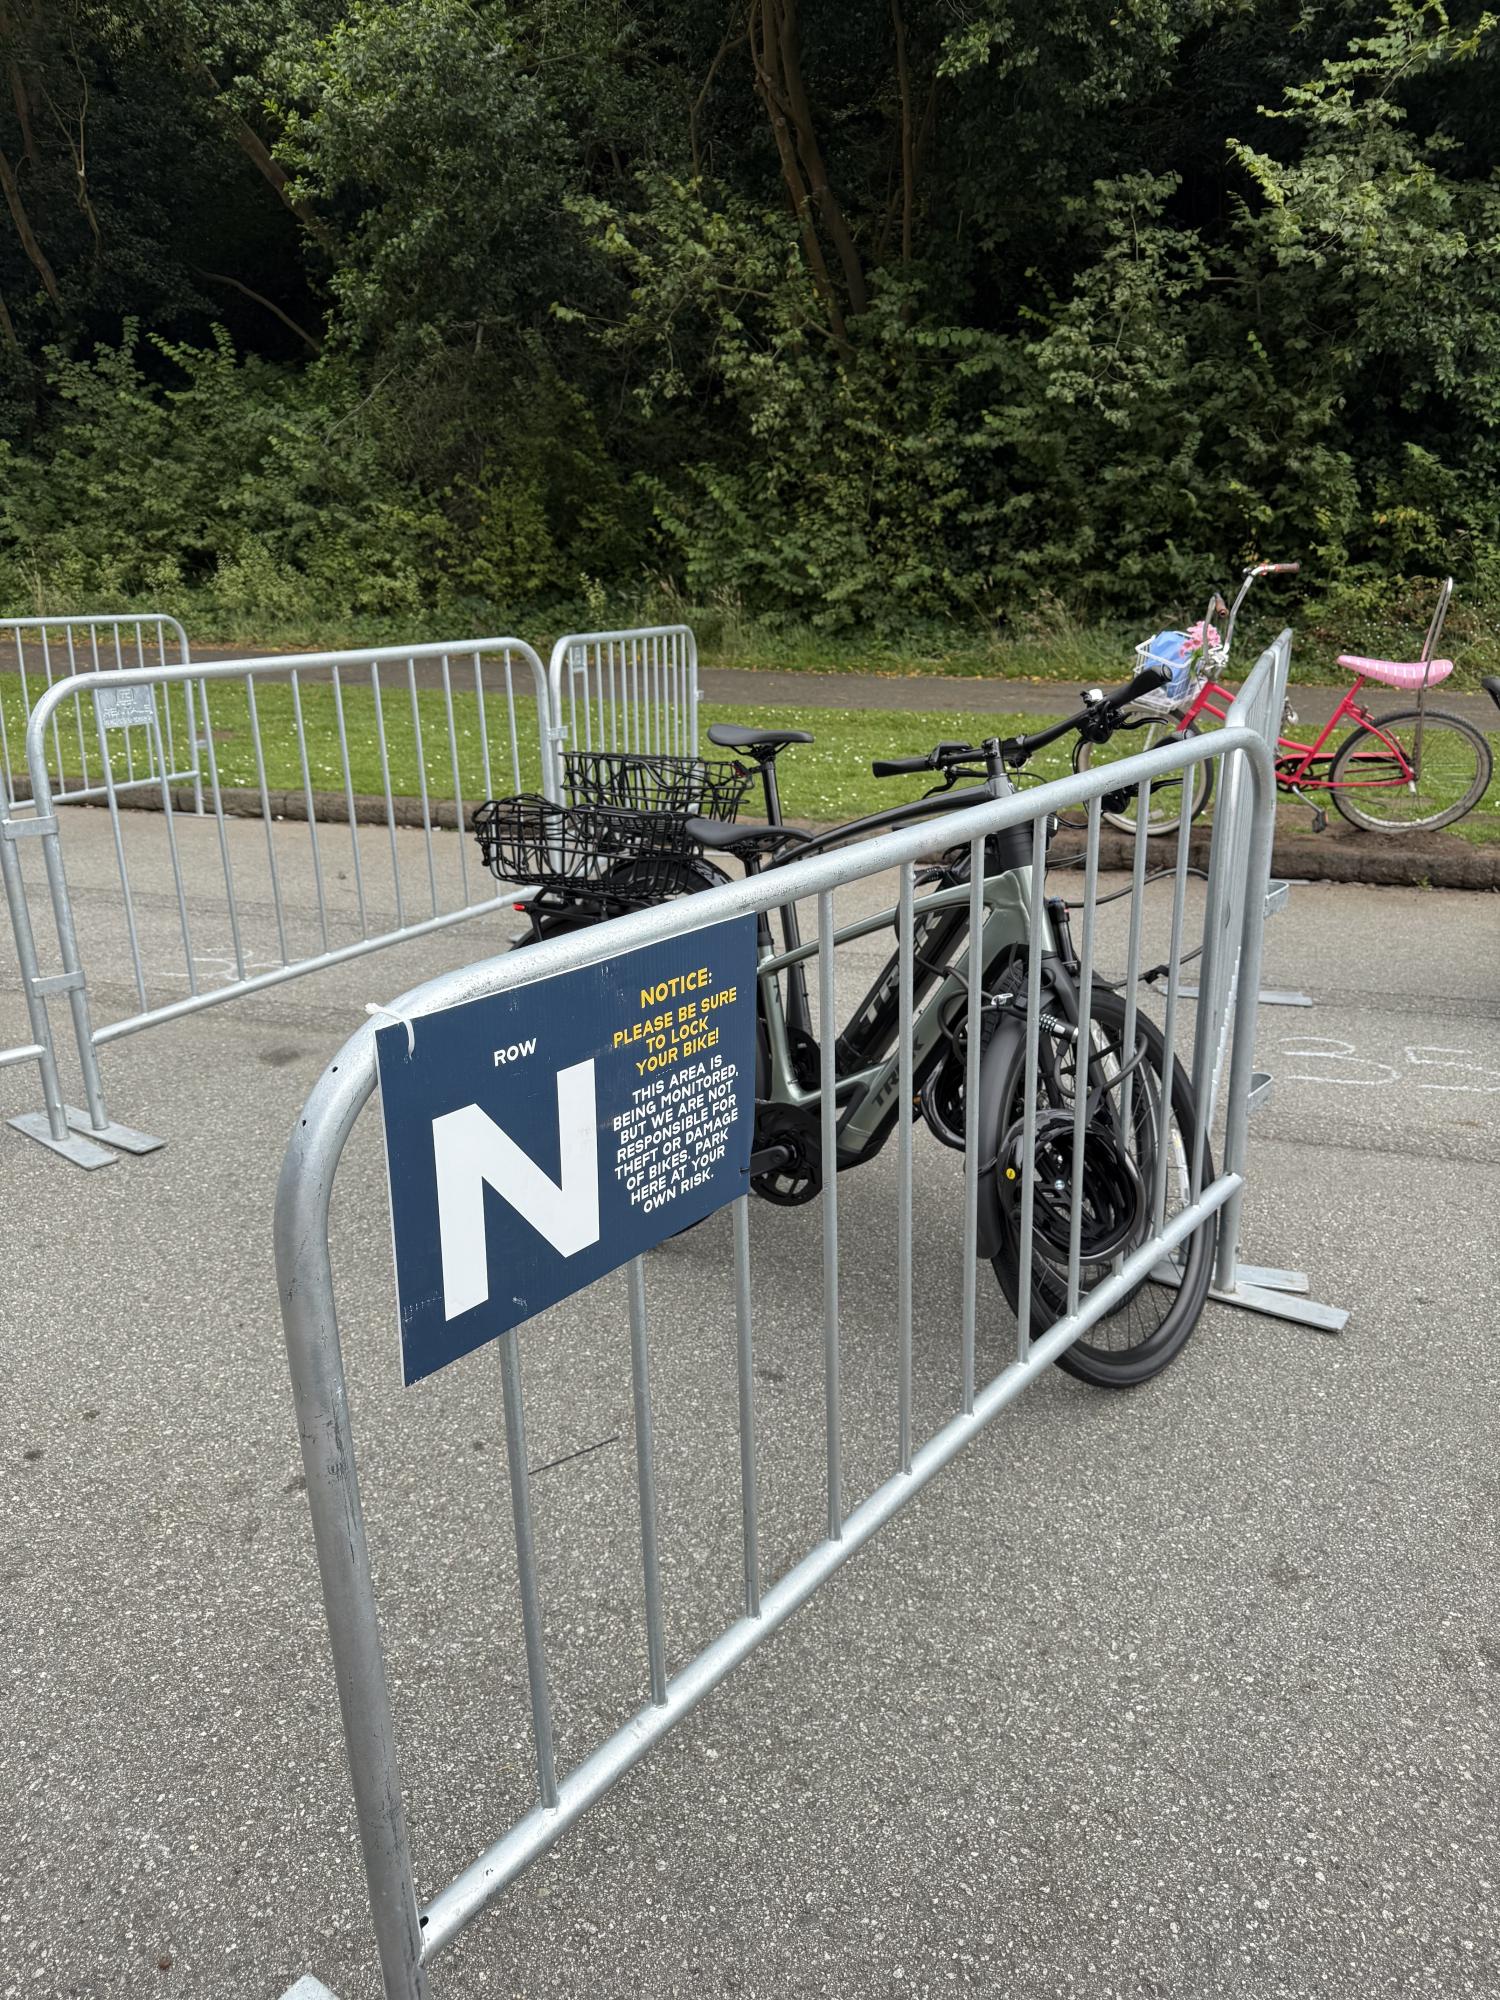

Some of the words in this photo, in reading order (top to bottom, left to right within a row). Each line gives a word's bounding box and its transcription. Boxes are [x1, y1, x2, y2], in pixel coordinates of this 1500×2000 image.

[641, 968, 712, 1008] NOTICE:
[860, 911, 943, 1024] TRK
[614, 1011, 673, 1048] PLEASE
[678, 1002, 696, 1023] BE
[701, 987, 736, 1013] SURE
[646, 1034, 666, 1053] TO
[671, 1015, 709, 1044] LOCK
[494, 1038, 537, 1067] ROW
[632, 1080, 664, 1104] THIS
[669, 1062, 706, 1089] AREA
[711, 1055, 722, 1070] IS
[636, 1047, 678, 1076] YOUR
[683, 1027, 719, 1057] BIKE!
[872, 1034, 925, 1107] TRK
[613, 1101, 656, 1131] BEING
[661, 1064, 738, 1109] MONITORED,
[617, 1107, 708, 1163] RESPONSIBLE
[713, 1094, 736, 1116] FOR
[621, 1120, 646, 1145] BUT
[651, 1108, 673, 1129] WE
[678, 1094, 704, 1117] ARE
[708, 1079, 733, 1102] NOT
[614, 1147, 658, 1180] THEFT
[663, 1137, 681, 1155] OR
[686, 1107, 738, 1145] DAMAGE
[627, 1171, 644, 1190] OF
[649, 1149, 691, 1179] BIKES.
[696, 1127, 728, 1155] PARK
[432, 1058, 600, 1322] N
[631, 1175, 666, 1205] HERE
[671, 1164, 687, 1184] AT
[691, 1145, 725, 1171] YOUR
[644, 1186, 676, 1213] OWN
[681, 1167, 714, 1194] RISK.
